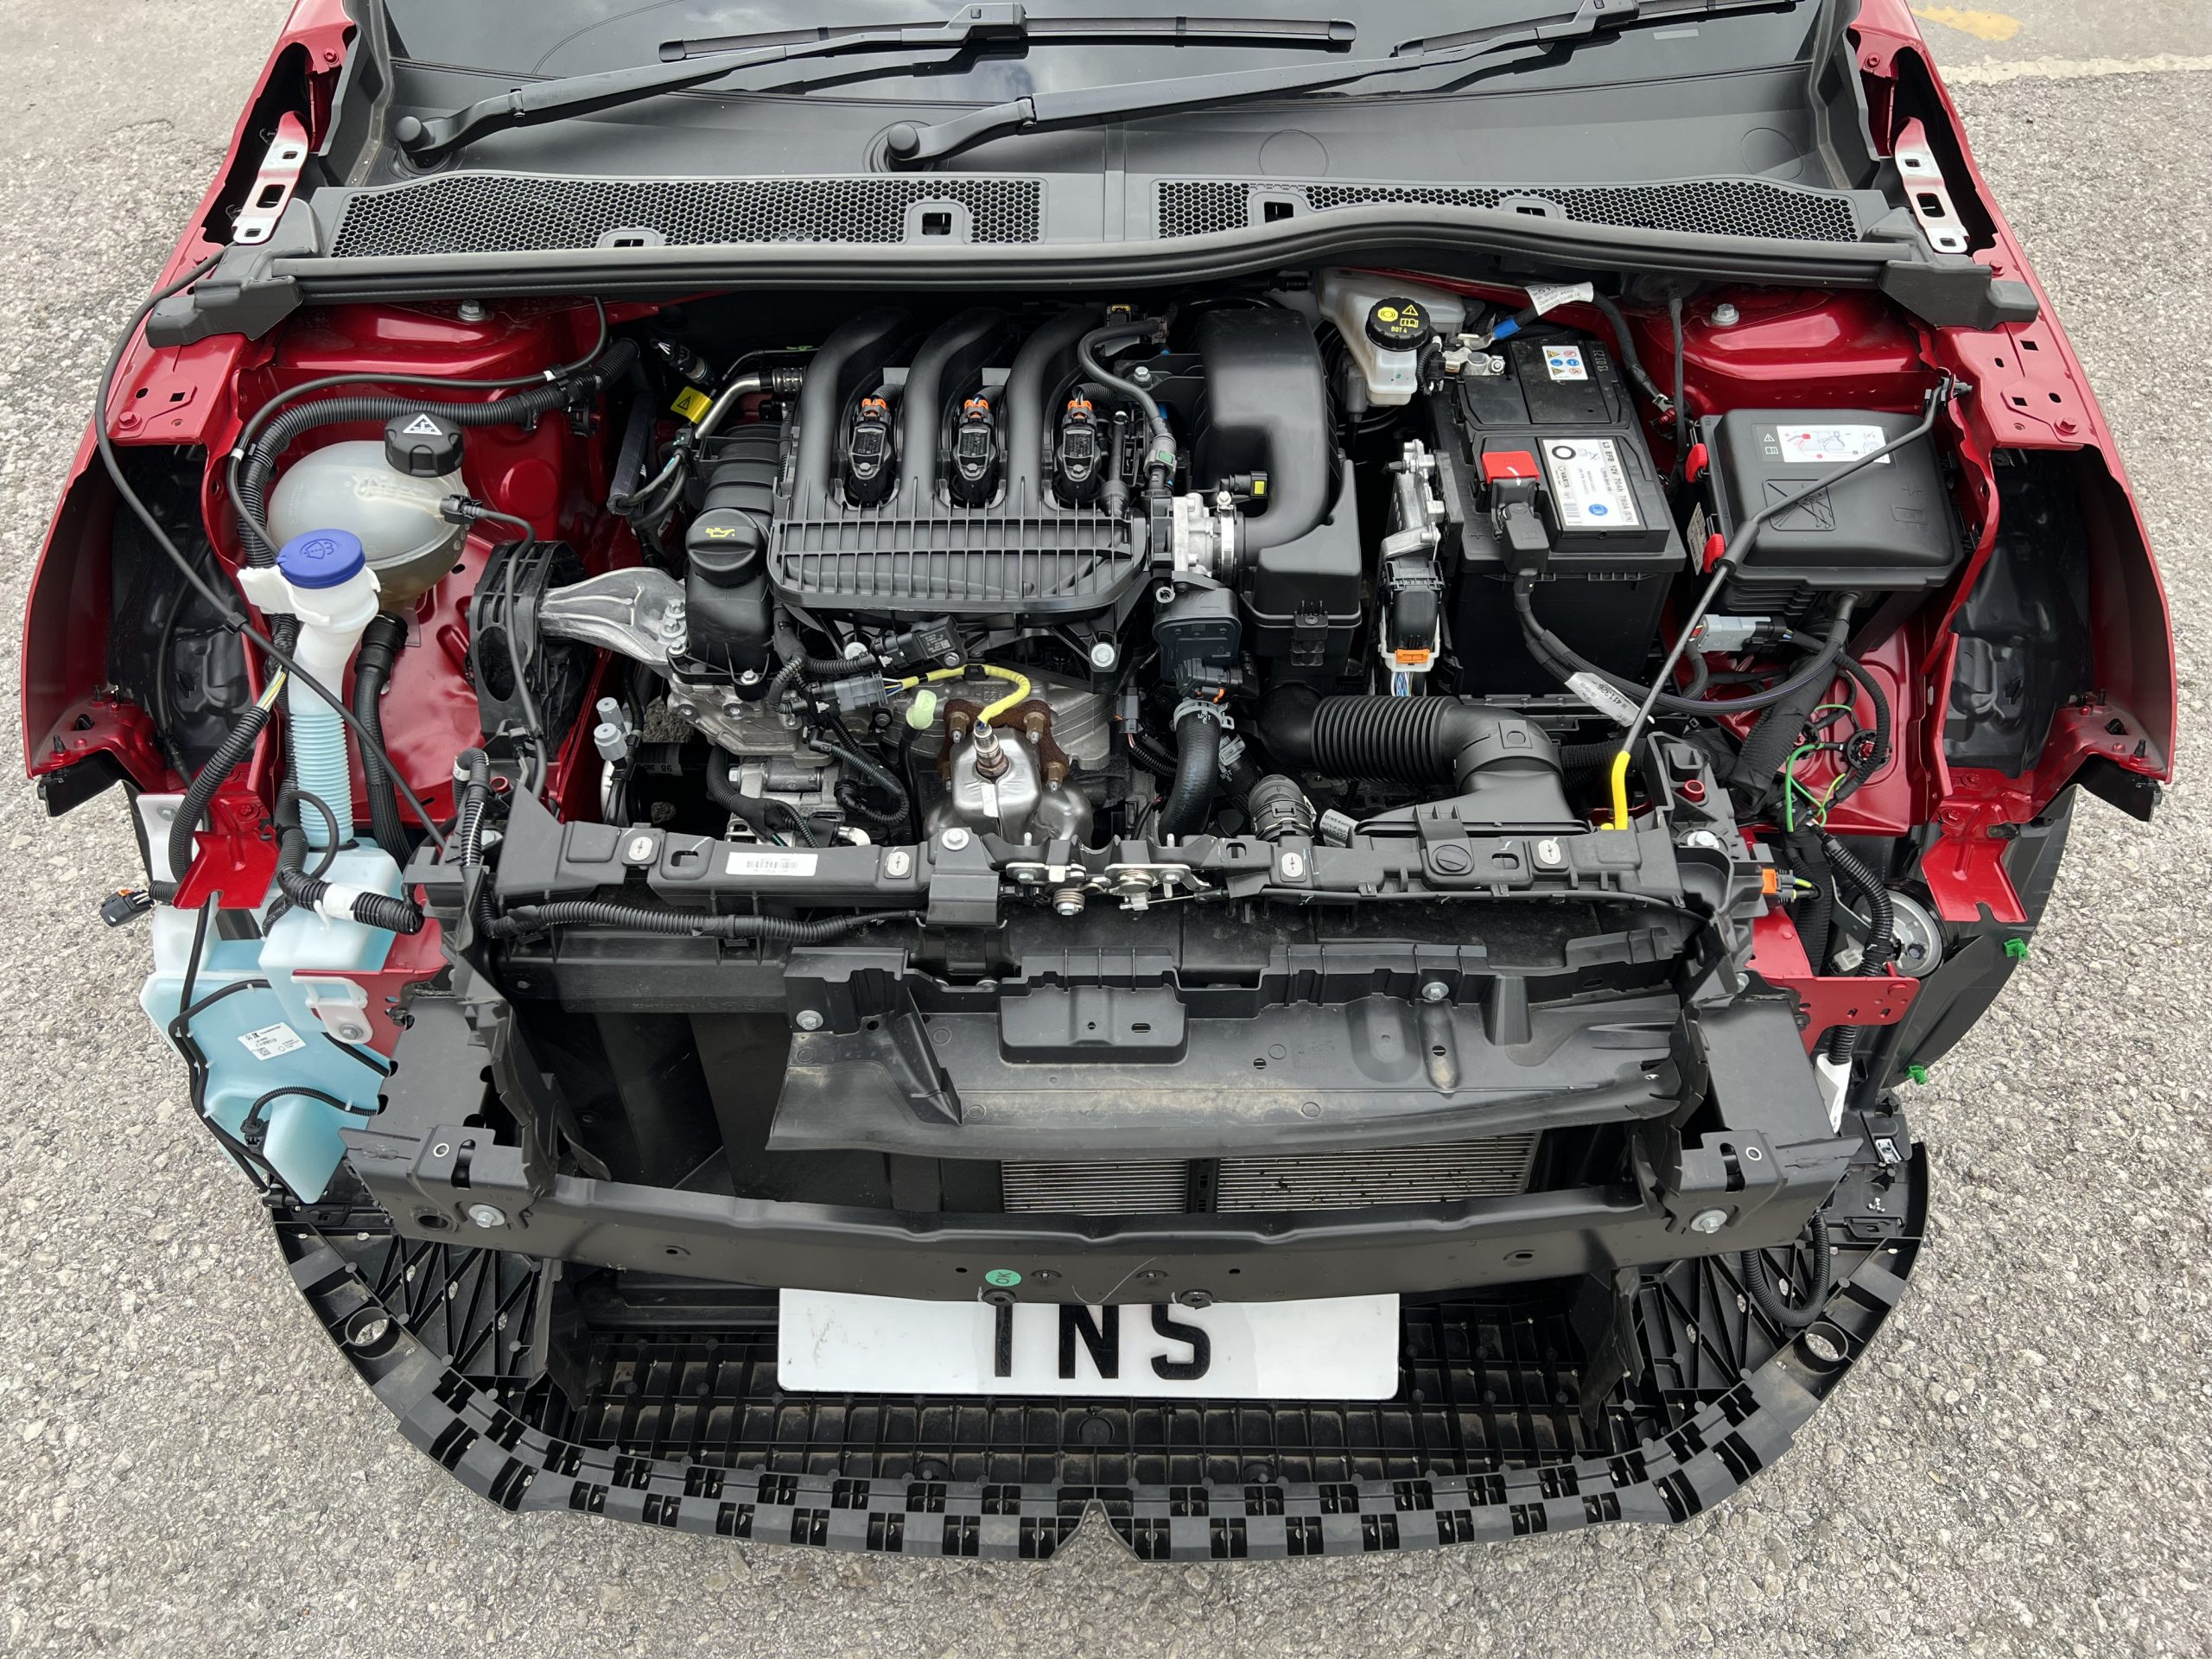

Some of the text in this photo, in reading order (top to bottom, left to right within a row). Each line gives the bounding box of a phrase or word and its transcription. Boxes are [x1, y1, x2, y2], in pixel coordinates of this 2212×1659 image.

[1560, 471, 1570, 488] VARTA
[1605, 451, 1615, 462] EFB
[1610, 465, 1618, 475] 12V
[1614, 478, 1624, 493] 70Ah
[995, 1271, 1012, 1285] OK
